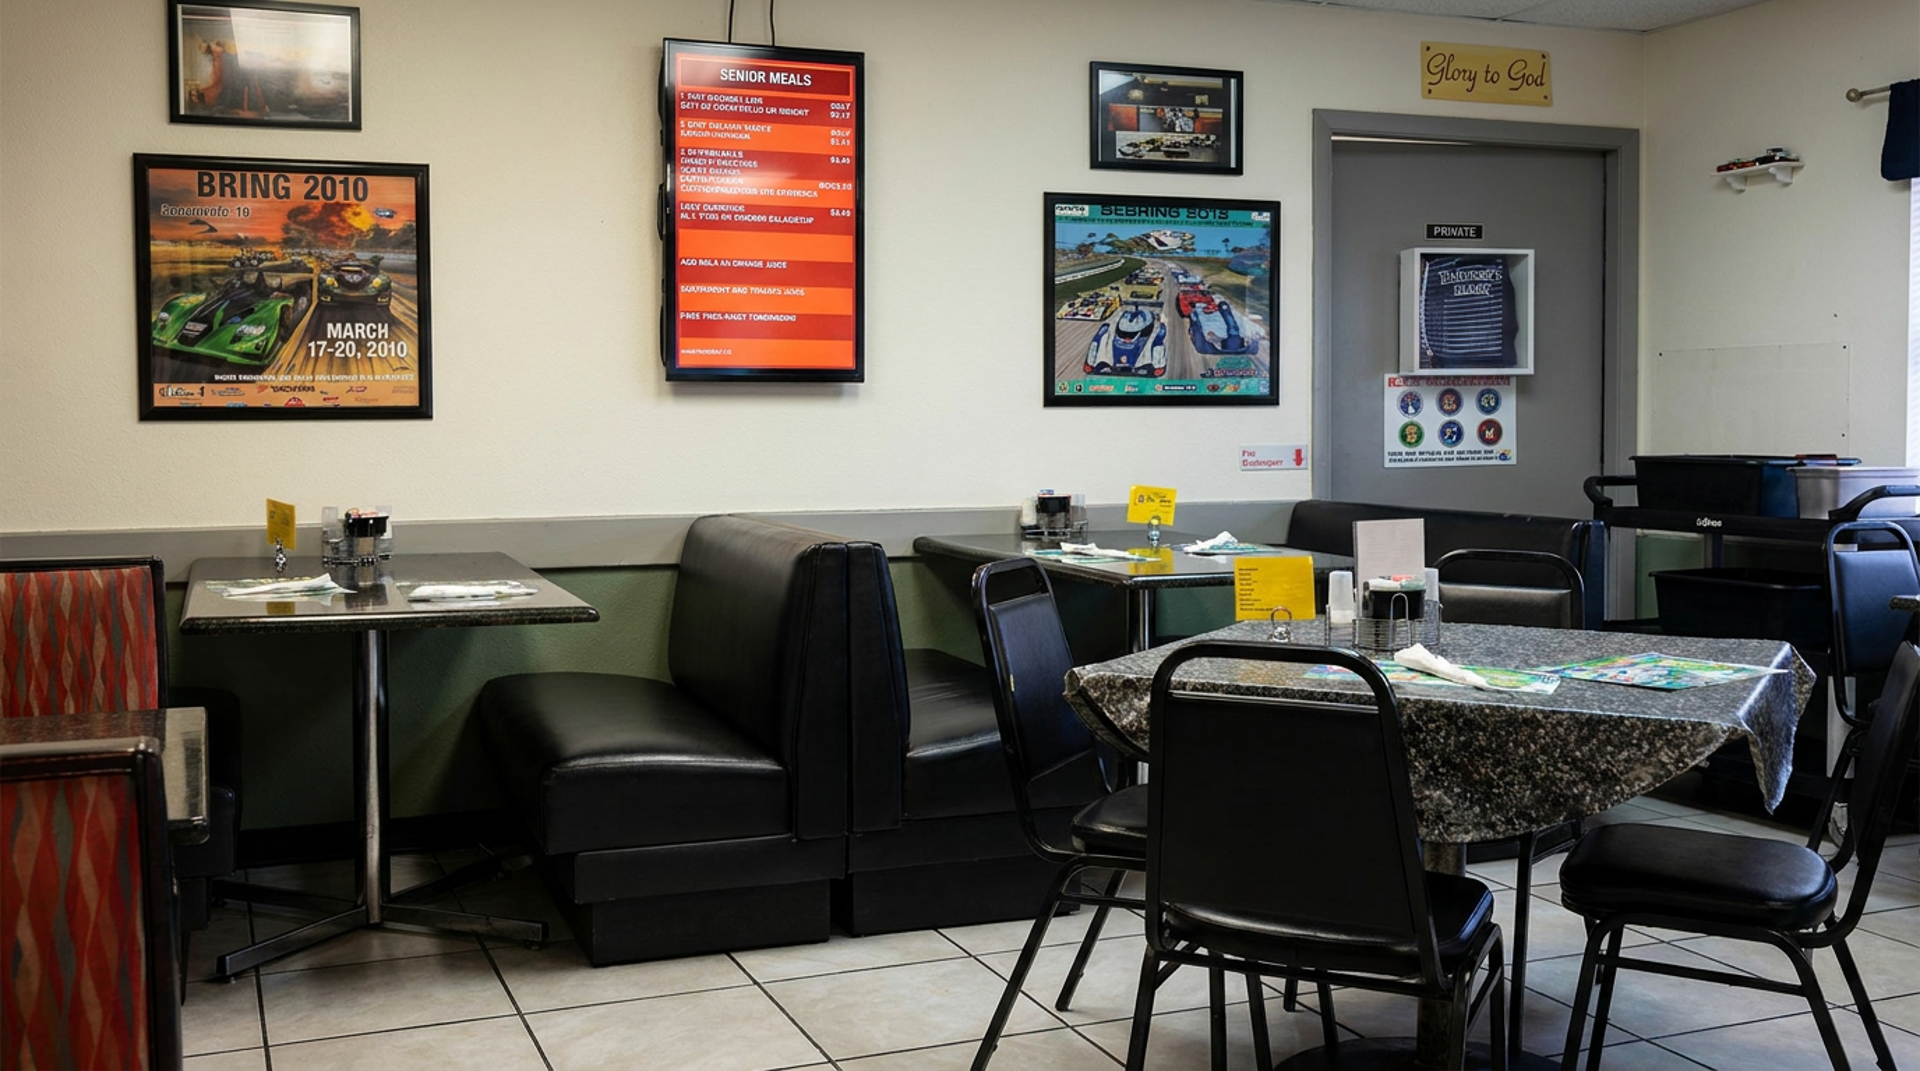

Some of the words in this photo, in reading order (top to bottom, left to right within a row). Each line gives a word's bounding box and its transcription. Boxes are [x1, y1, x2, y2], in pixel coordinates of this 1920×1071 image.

[720, 68, 766, 83] SENIOR
[769, 71, 812, 86] MEALS
[1427, 53, 1477, 92] Glory
[1484, 64, 1500, 84] to
[1507, 59, 1546, 91] God
[197, 171, 291, 200] BRING
[303, 174, 368, 202] 2010
[1100, 205, 1180, 219] SEBRING
[1433, 226, 1477, 237] PRIVATE
[327, 322, 389, 339] MARCH
[308, 340, 361, 360] 17-20,
[366, 340, 408, 358] 2010
